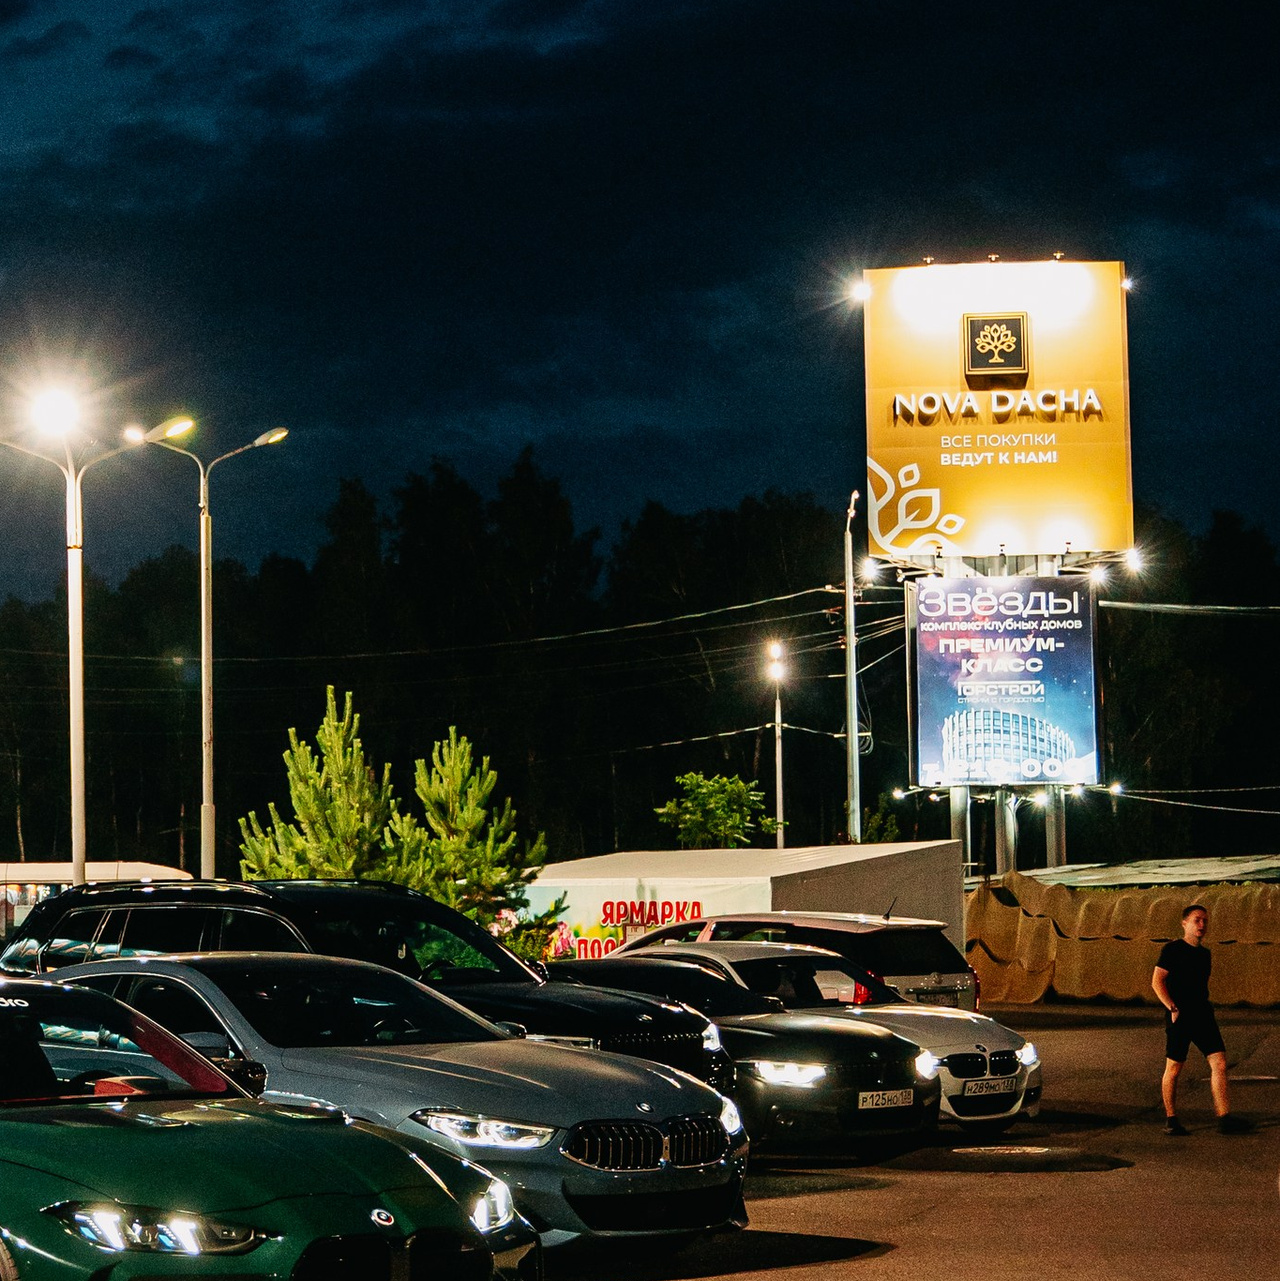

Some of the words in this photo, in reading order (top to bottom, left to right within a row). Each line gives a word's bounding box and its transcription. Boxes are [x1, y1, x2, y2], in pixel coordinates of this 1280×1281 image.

[895, 392, 979, 416] NOVA
[990, 388, 1102, 412] DACHA
[940, 435, 972, 448] ВСЕ
[976, 433, 1056, 448] ПОКУПКИ
[940, 452, 995, 467] ВЕДУТ
[998, 452, 1010, 464] К
[1014, 451, 1058, 464] НАМ!
[918, 587, 1079, 618] Звёзды
[920, 620, 982, 632] комплекс
[984, 618, 1039, 633] клубных
[1040, 619, 1083, 631] домов
[961, 658, 1044, 674] КЛАСС
[601, 900, 703, 926] ЯРМАРКА
